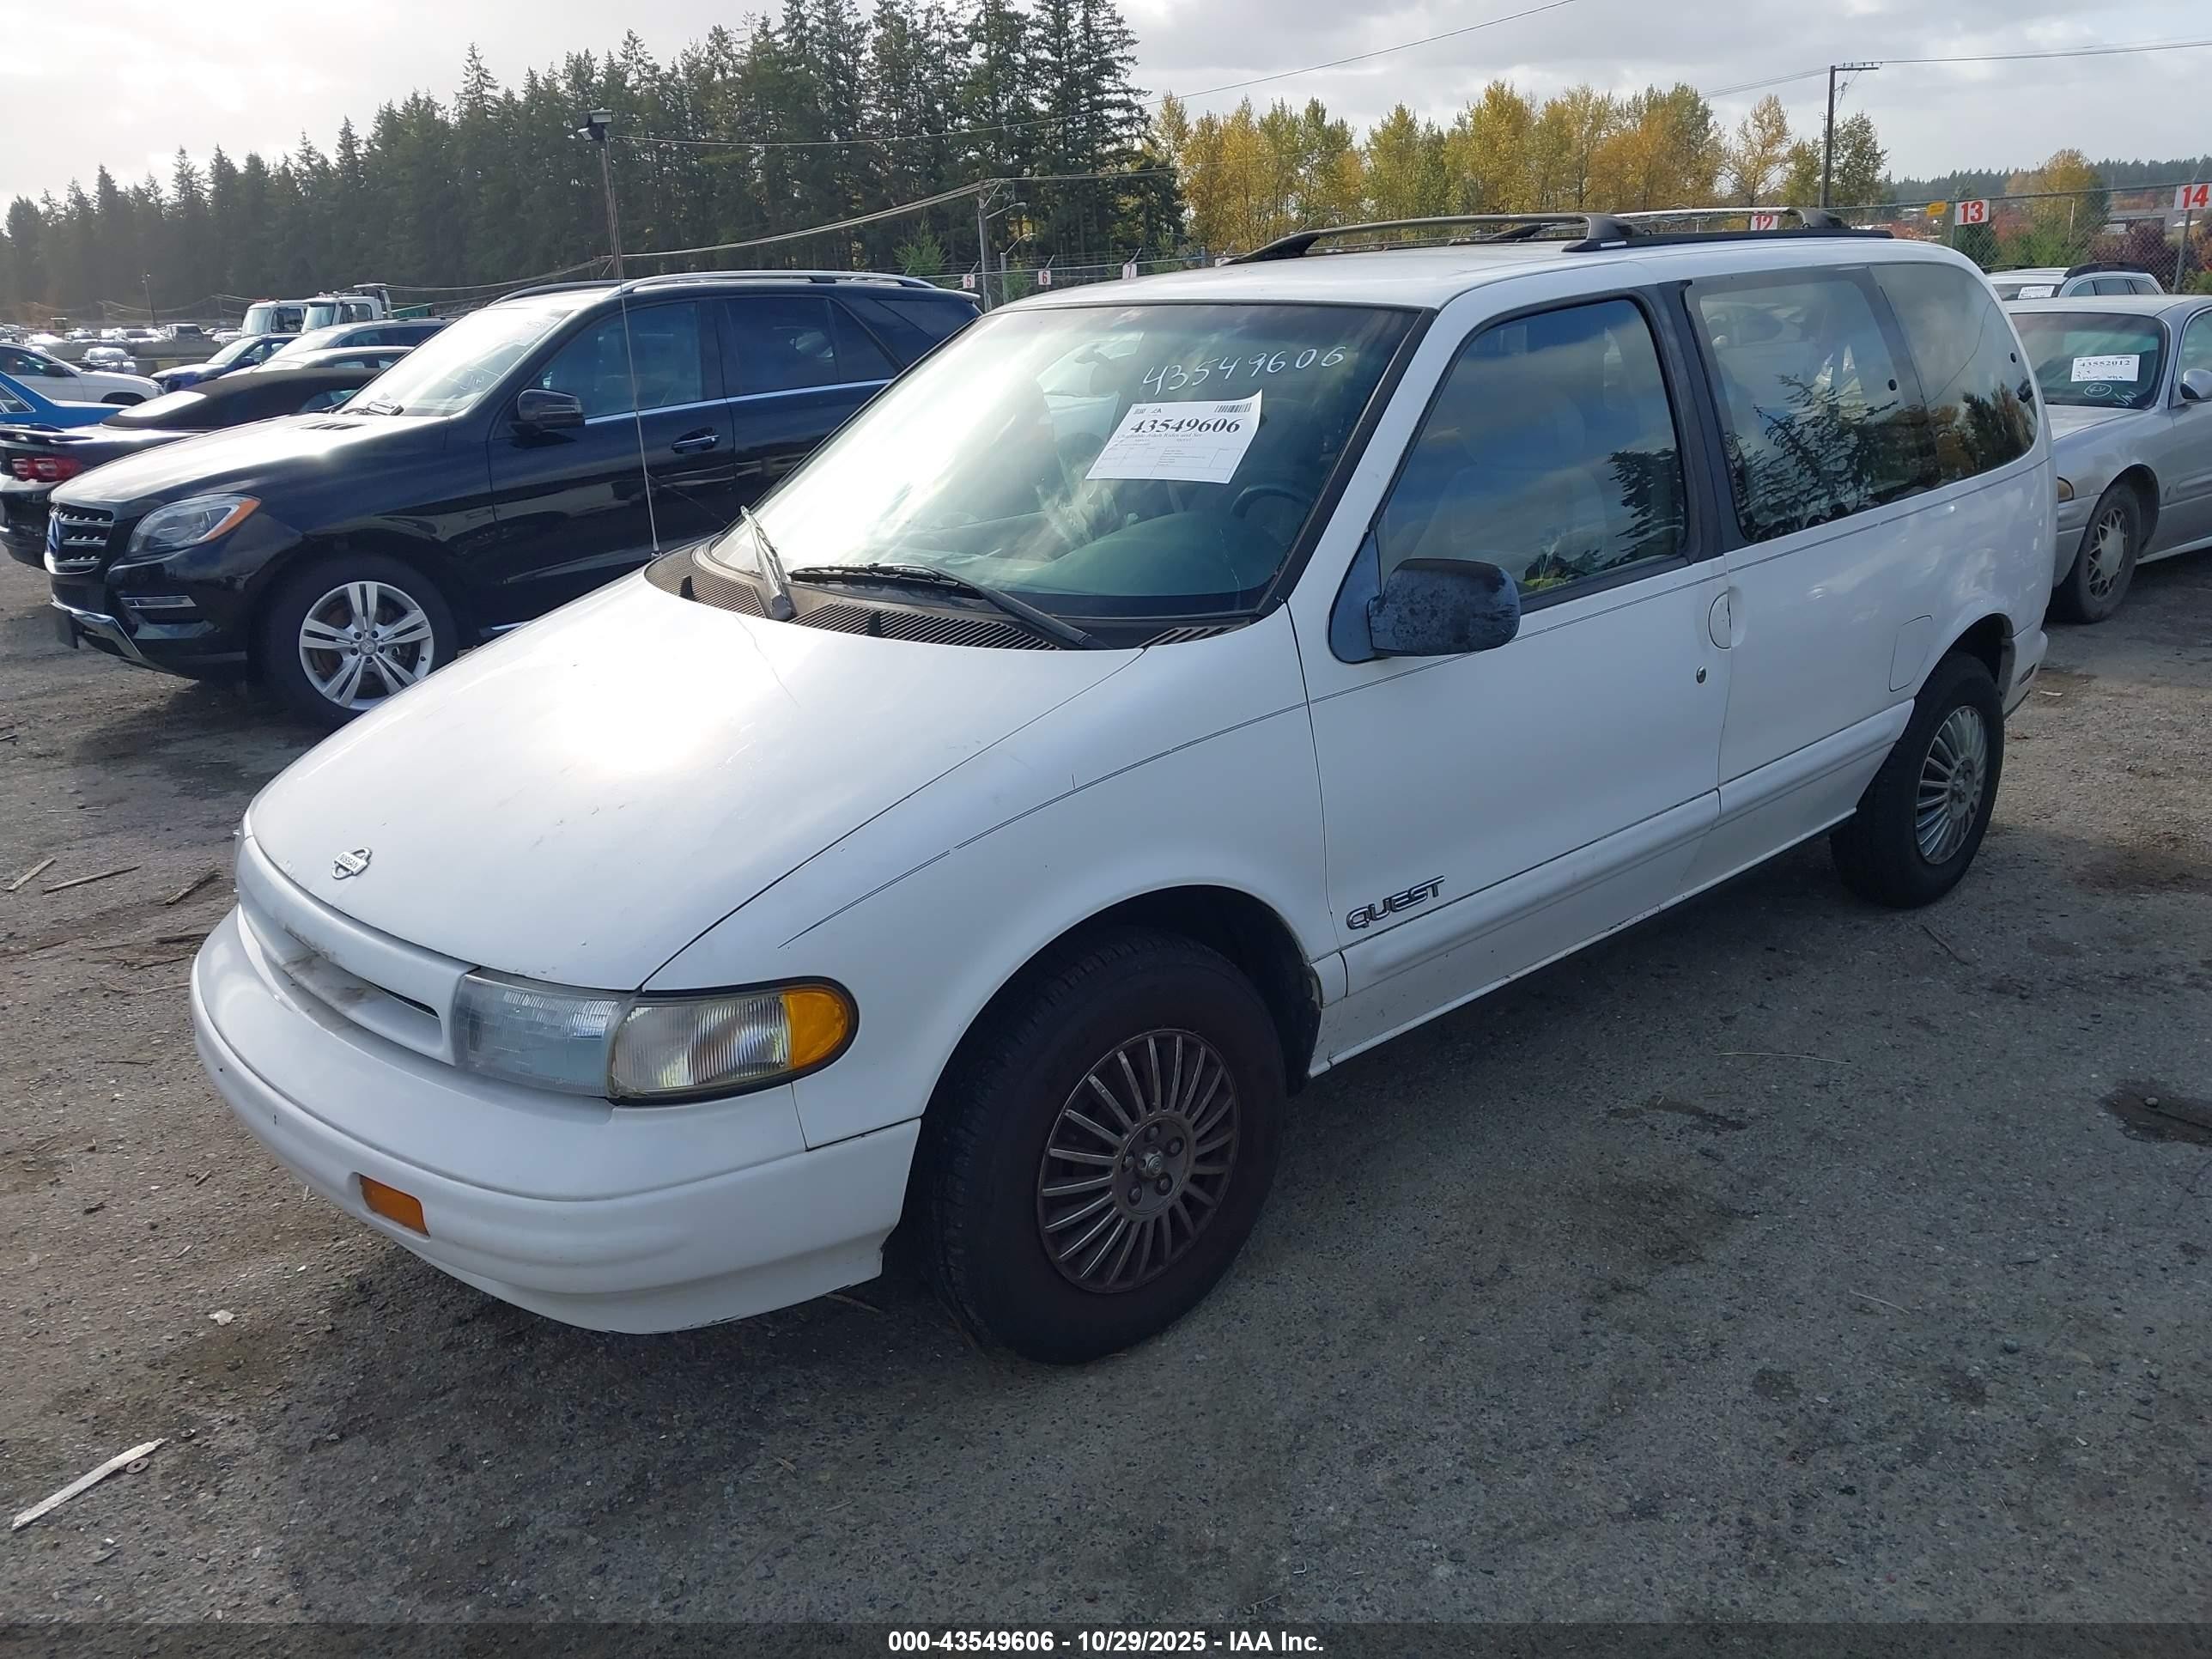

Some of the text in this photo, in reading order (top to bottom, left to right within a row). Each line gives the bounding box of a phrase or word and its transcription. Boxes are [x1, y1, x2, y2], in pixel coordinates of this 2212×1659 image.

[2183, 185, 2209, 208] 14
[1961, 201, 1984, 222] 13
[1756, 215, 1773, 230] 12
[966, 275, 971, 288] 5
[1042, 270, 1048, 283] 6
[1143, 346, 1346, 395] 43549606
[1130, 417, 1244, 434] 43549606
[1346, 875, 1446, 930] QUEST
